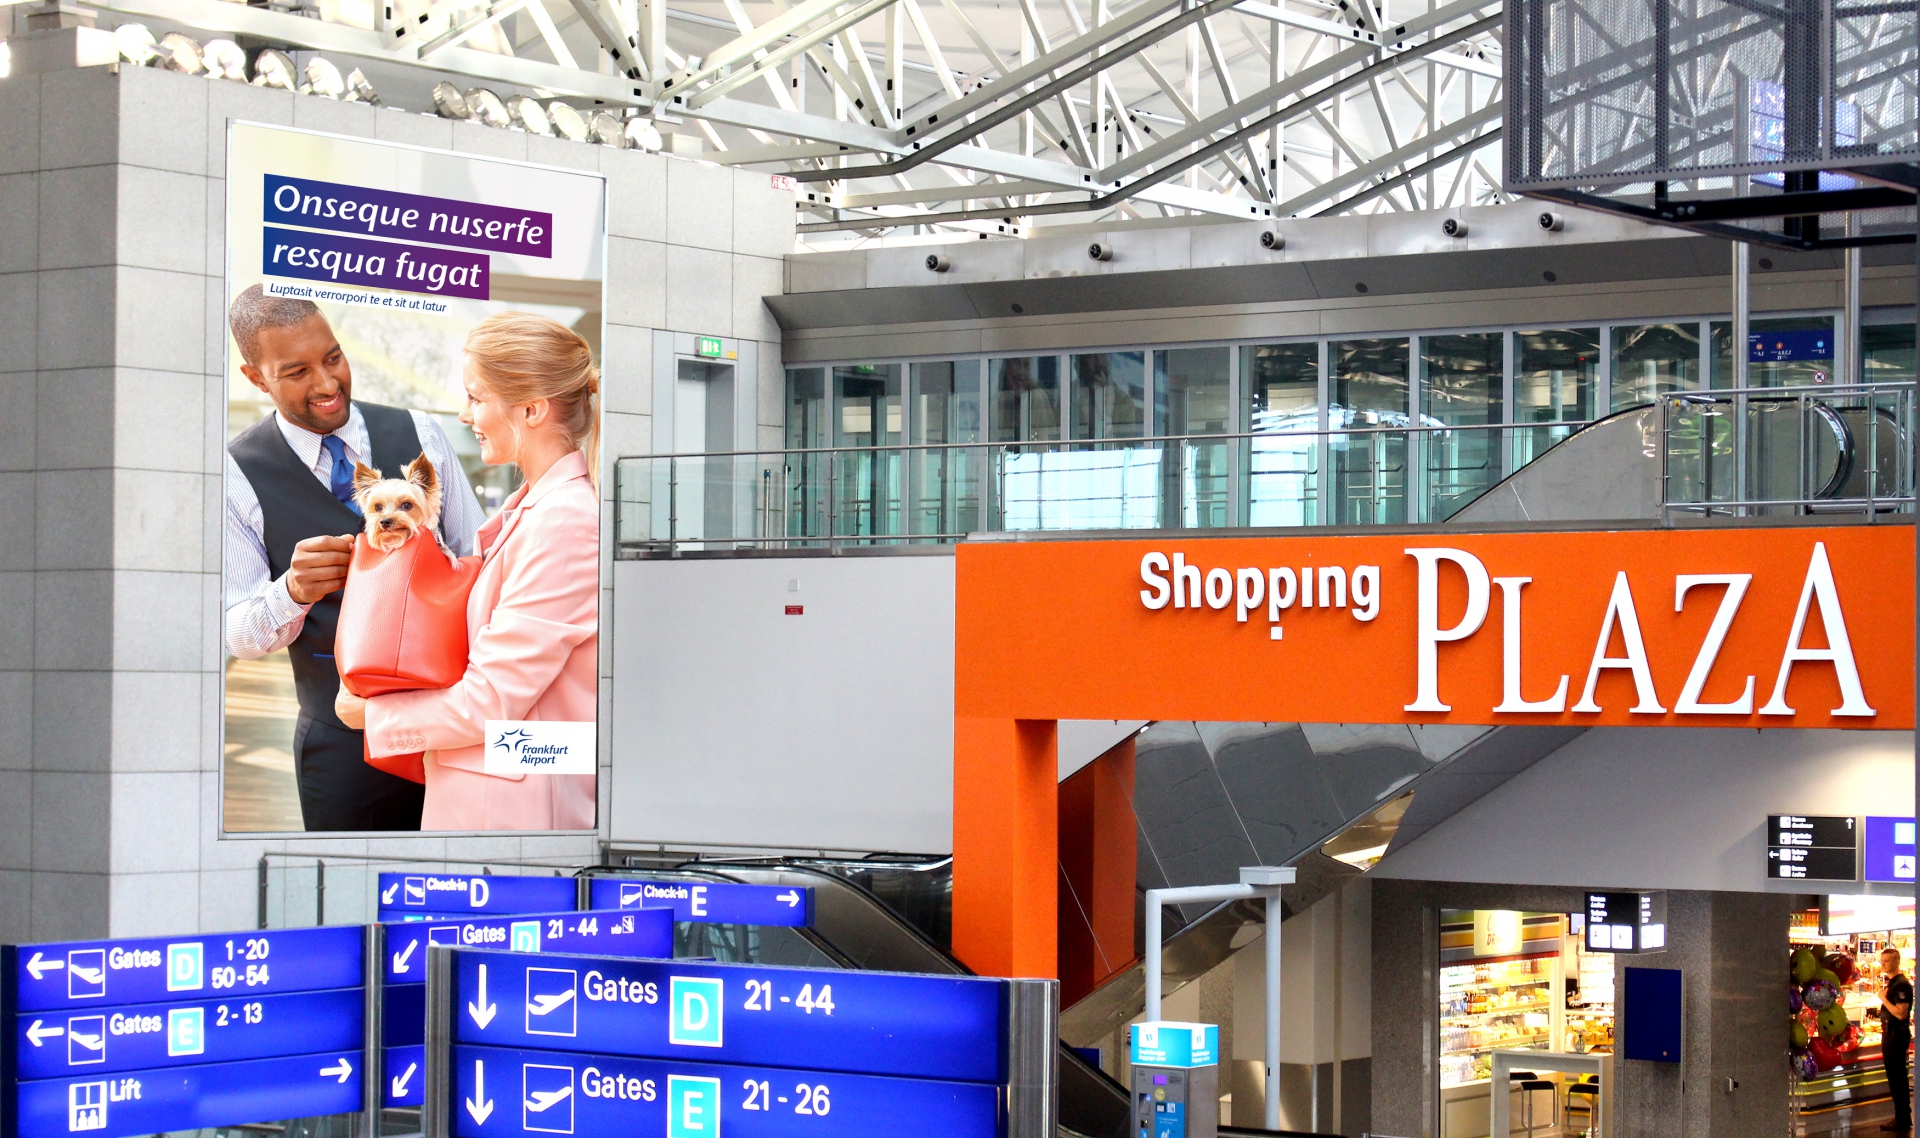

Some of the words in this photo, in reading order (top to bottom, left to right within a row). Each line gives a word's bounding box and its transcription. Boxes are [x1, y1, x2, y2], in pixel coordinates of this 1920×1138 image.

[274, 185, 419, 232] Onseque
[428, 212, 544, 245] nuserfe
[272, 244, 386, 280] resqua
[395, 251, 482, 291] fugat
[270, 282, 313, 297] Luptasit
[314, 290, 368, 304] verrorpori
[369, 295, 380, 305] te
[382, 297, 393, 306] et
[395, 298, 407, 308] sit
[408, 300, 421, 310] ut
[422, 300, 447, 312] latur
[1140, 551, 1381, 640] Shopping
[1404, 541, 1877, 716] PLAZA
[520, 754, 556, 767] Airport
[521, 744, 569, 755] Frankfurt
[426, 877, 468, 892] Check-in
[470, 878, 490, 908] D
[643, 884, 689, 900] Check-in
[691, 886, 708, 917] E
[462, 923, 507, 945] Gates
[109, 946, 162, 971] Gates
[176, 953, 195, 981] D
[583, 970, 659, 1005] Gates
[683, 993, 709, 1031] D
[109, 1012, 163, 1036] Gates
[178, 1017, 194, 1046] E
[109, 1077, 142, 1103] Lift
[581, 1066, 657, 1102] Gates
[684, 1092, 704, 1130] E
